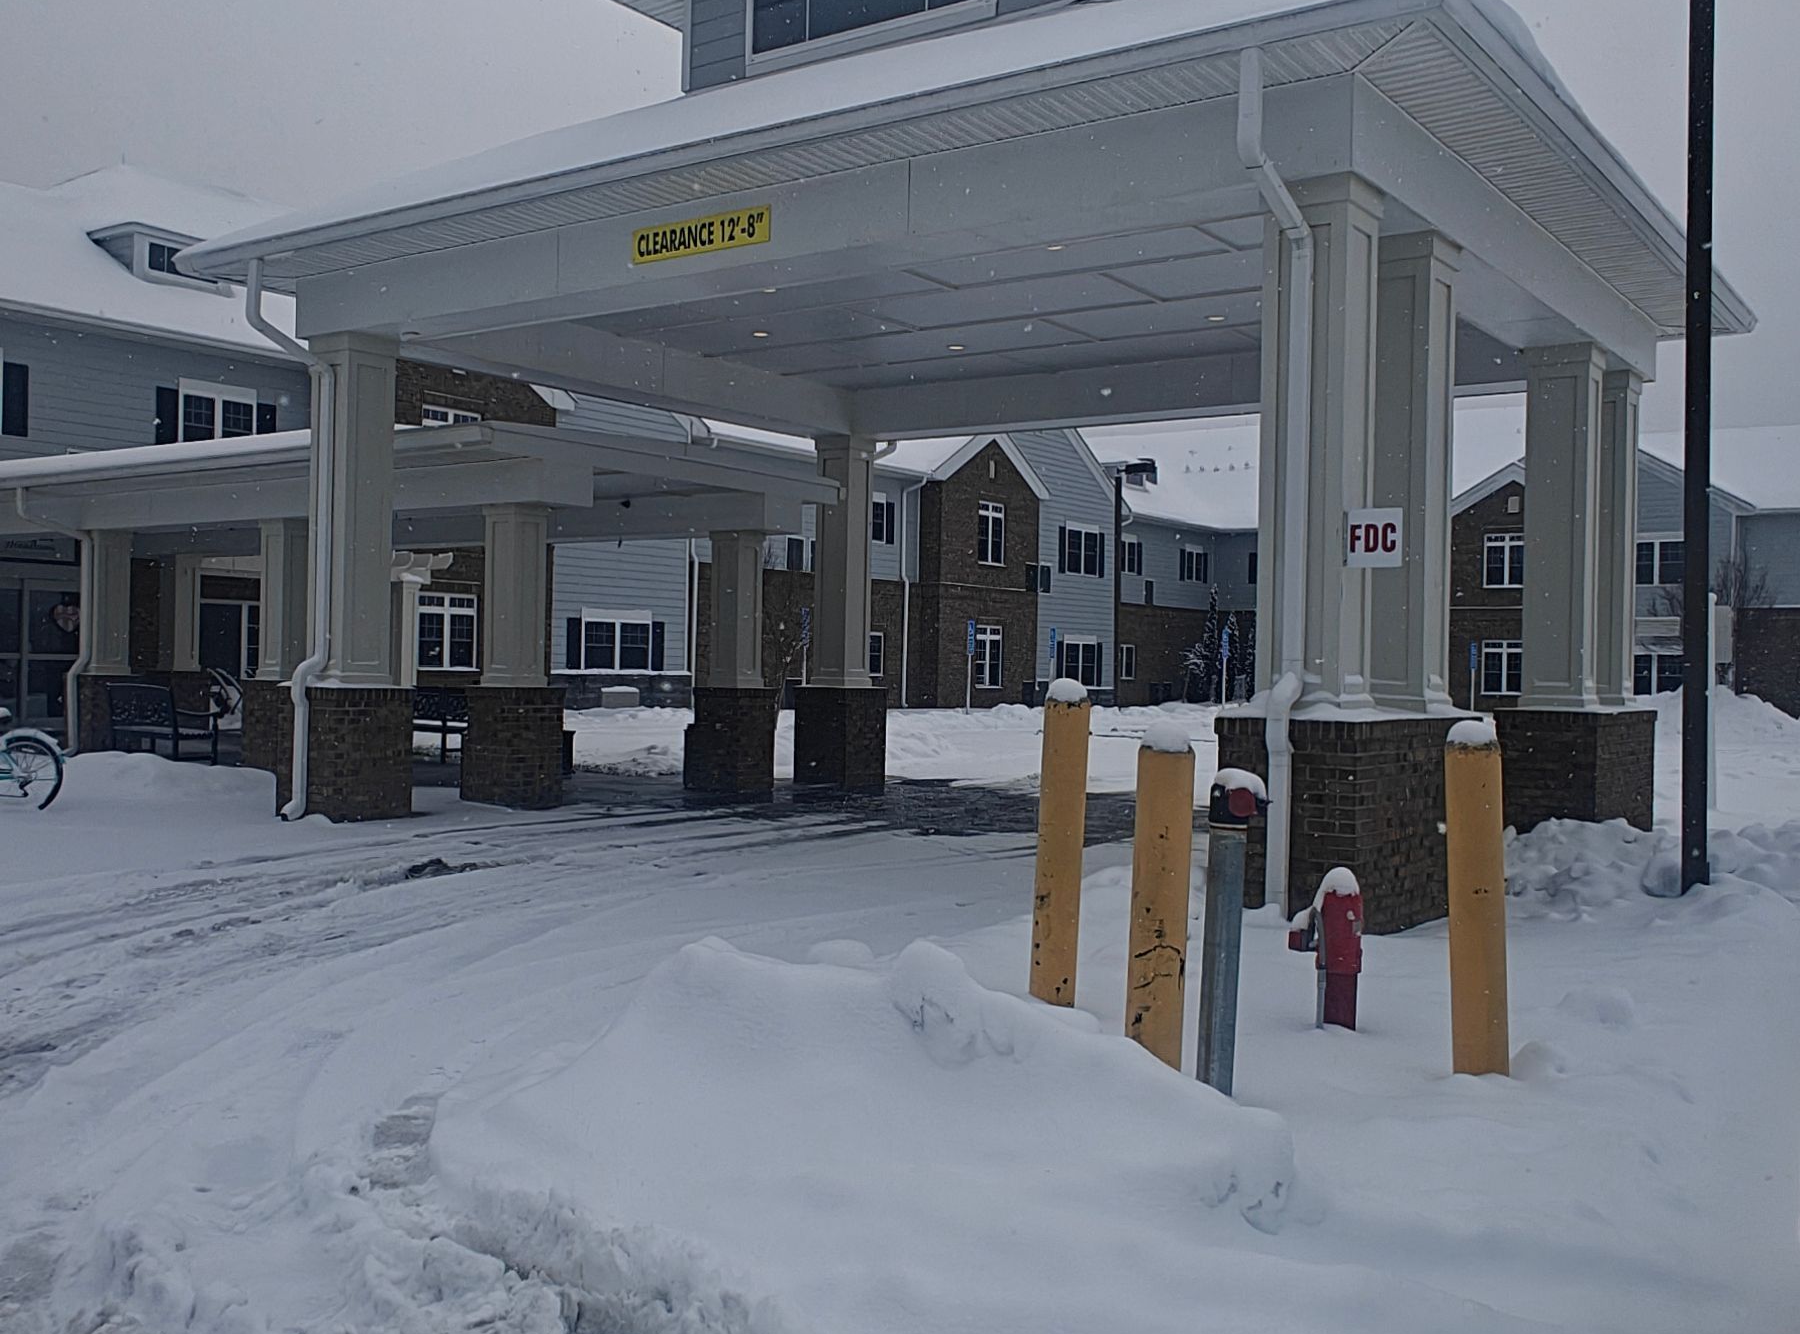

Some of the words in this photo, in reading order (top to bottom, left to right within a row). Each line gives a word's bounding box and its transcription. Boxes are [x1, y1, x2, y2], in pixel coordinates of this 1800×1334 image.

[637, 221, 714, 257] CLEARANCE
[720, 212, 764, 243] 12'-8"
[1350, 522, 1396, 553] FDC
